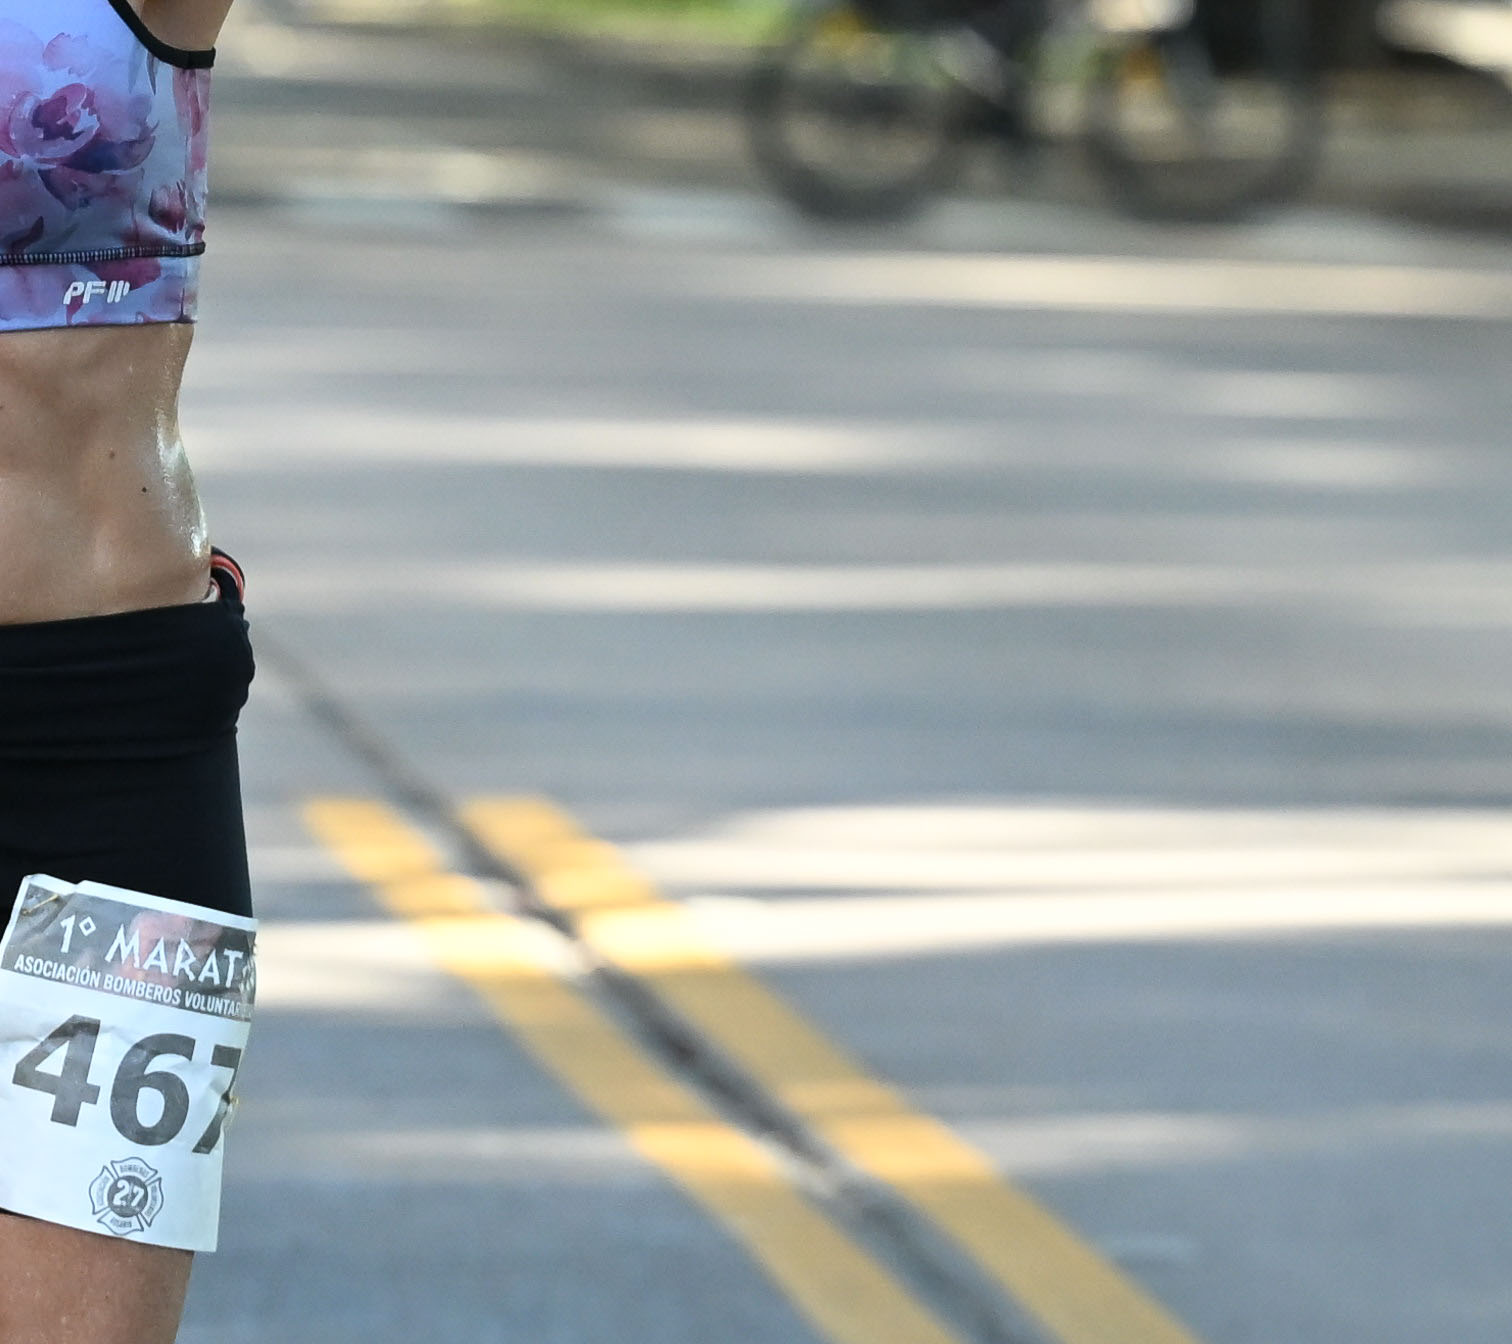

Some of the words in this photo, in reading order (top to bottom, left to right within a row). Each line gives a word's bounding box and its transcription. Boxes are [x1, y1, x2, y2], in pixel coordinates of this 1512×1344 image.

[14, 954, 101, 988] ASOCIACIÓN
[103, 974, 182, 1006] BOMBEROS
[12, 1014, 243, 1155] 467
[113, 1179, 145, 1207] 27
